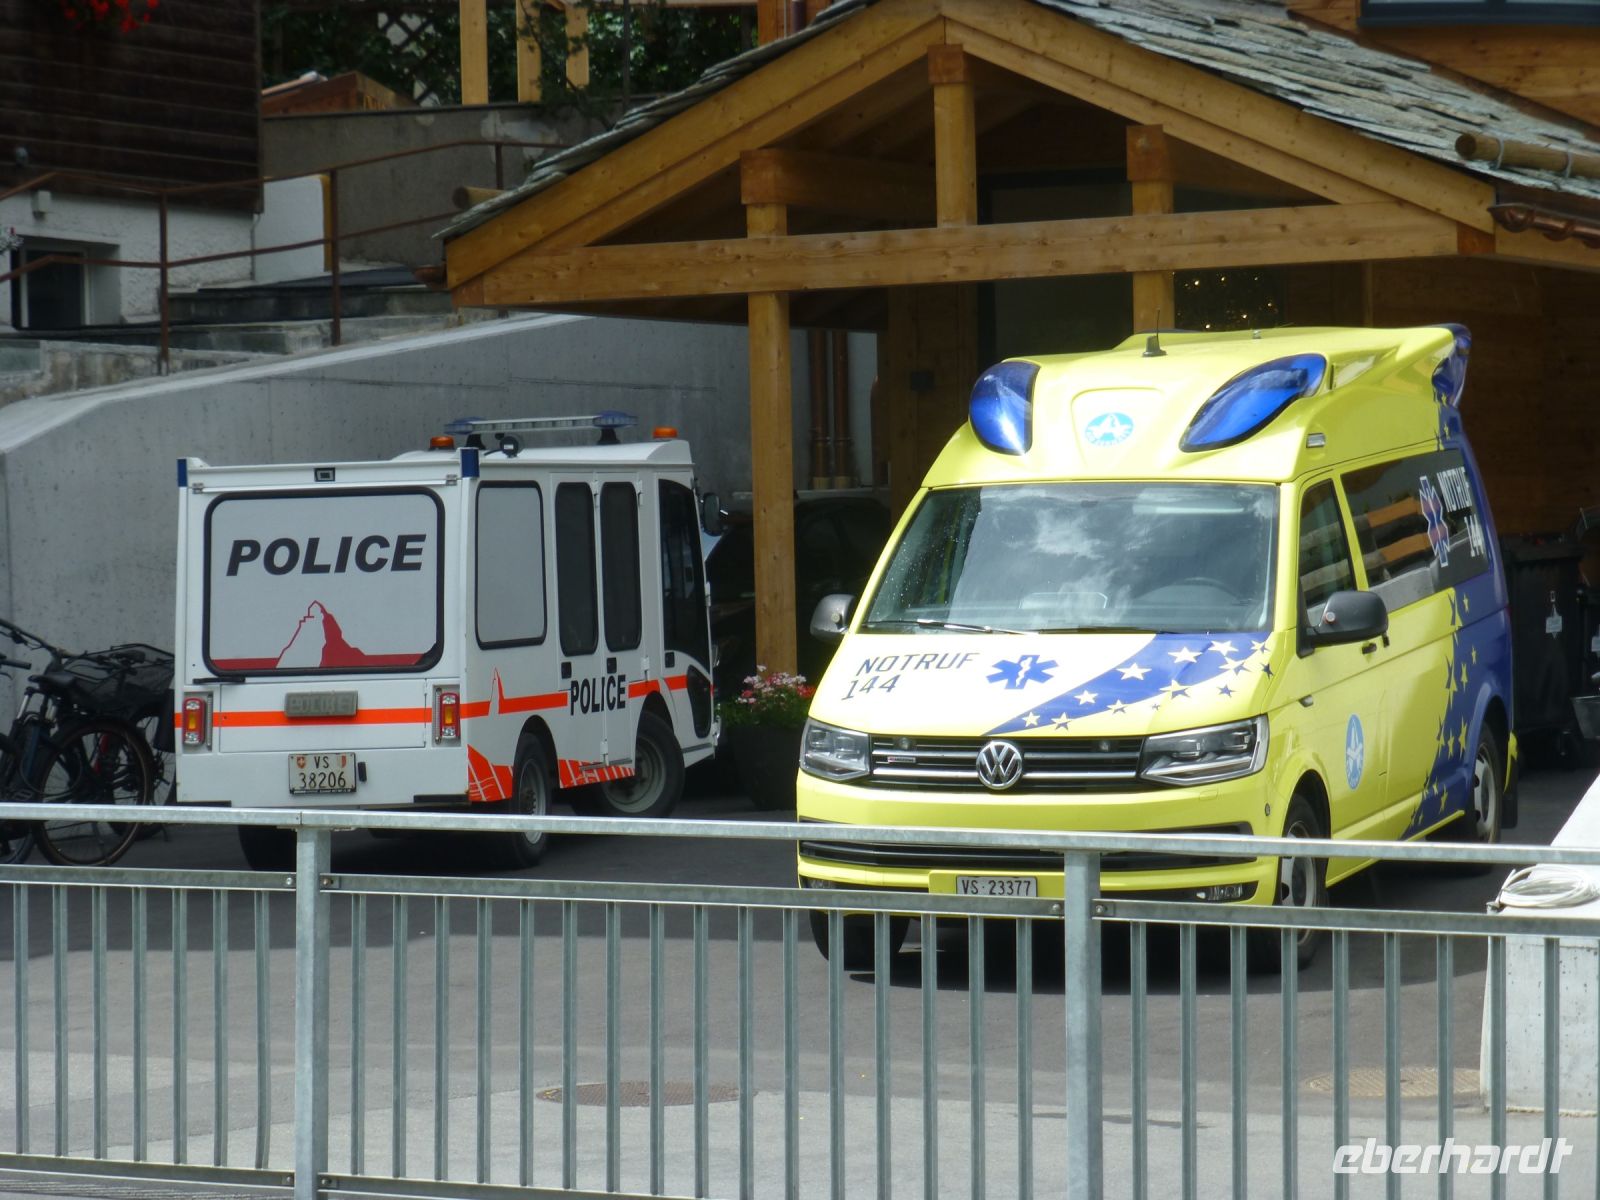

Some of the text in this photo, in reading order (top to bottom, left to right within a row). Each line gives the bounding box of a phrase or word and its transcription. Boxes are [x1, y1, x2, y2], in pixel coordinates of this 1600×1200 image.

[226, 534, 426, 576] POLICE
[856, 652, 980, 676] NOTRUF
[571, 674, 626, 716] POLICE
[841, 674, 901, 700] 144
[314, 755, 330, 769] VS
[299, 771, 346, 789] 38206
[961, 879, 1031, 897] VS 23377
